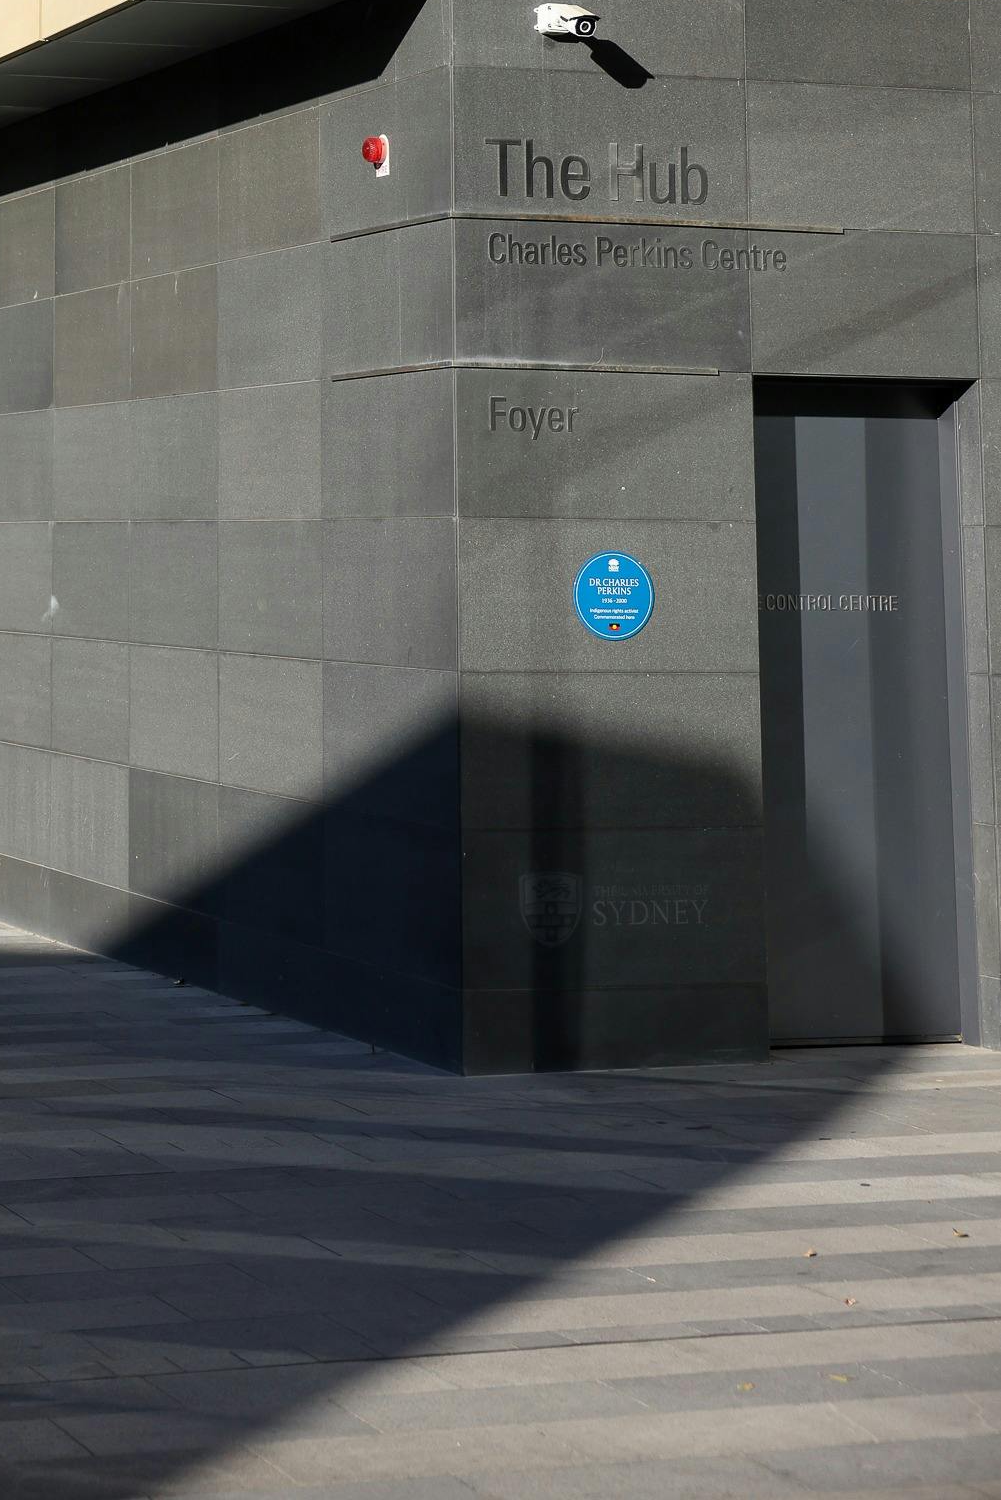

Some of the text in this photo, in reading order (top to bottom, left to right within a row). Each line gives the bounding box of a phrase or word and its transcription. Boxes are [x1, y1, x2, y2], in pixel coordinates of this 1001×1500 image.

[484, 138, 709, 205] The Hub
[487, 232, 787, 272] Charles Perkins Centre
[489, 395, 580, 441] Foyer
[589, 578, 640, 587] DR CHARLES
[597, 587, 631, 595] PERKINS
[766, 594, 837, 611] CONTROL
[839, 595, 899, 612] CENTRE
[592, 899, 709, 926] SYDNEY
